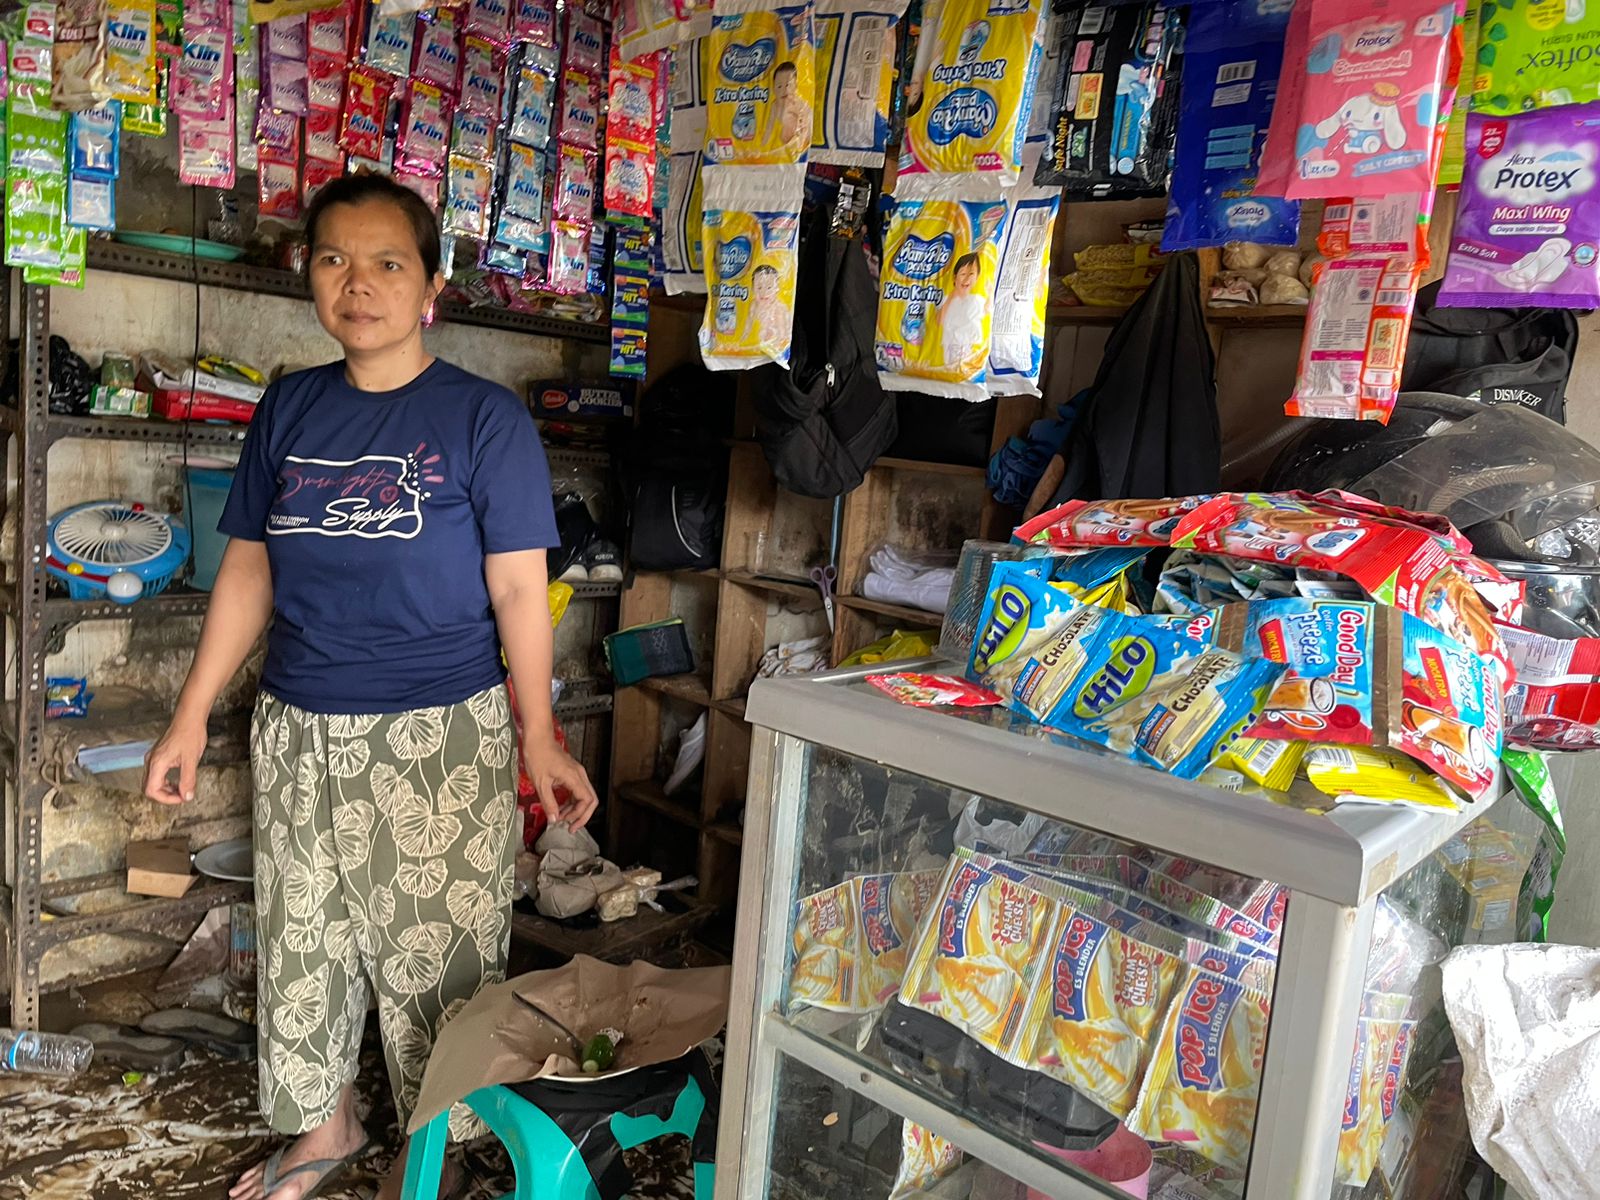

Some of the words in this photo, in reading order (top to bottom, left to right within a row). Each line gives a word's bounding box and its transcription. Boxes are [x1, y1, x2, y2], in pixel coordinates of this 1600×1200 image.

[108, 21, 147, 41] Klin
[375, 29, 408, 49] Klin
[573, 32, 599, 50] Klin
[1355, 34, 1395, 48] Protex
[1542, 34, 1573, 46] SIRIH
[184, 42, 221, 61] Klin
[426, 43, 456, 63] Klin
[468, 75, 498, 94] Klin
[739, 86, 769, 103] Kering
[350, 115, 378, 134] Klin
[521, 106, 547, 125] Klin
[568, 107, 594, 125] Klin
[411, 121, 444, 141] Klin
[460, 118, 487, 136] Klin
[1055, 116, 1068, 148] Night
[1505, 152, 1536, 167] Hers
[513, 180, 539, 198] Klin
[1494, 167, 1582, 193] Protex
[454, 199, 480, 212] Klin
[1492, 206, 1530, 220] Maxi
[1533, 205, 1572, 223] Wing
[1496, 225, 1514, 233] Daya
[624, 240, 641, 250] HIT
[1458, 243, 1479, 254] Extra
[1480, 248, 1498, 259] Soft
[622, 292, 639, 303] HIT
[910, 284, 944, 306] Kering
[620, 344, 636, 354] HIT
[579, 397, 622, 407] COOKIES
[580, 388, 621, 398] BUTTER
[322, 496, 406, 531] Supply
[1322, 608, 1334, 632] Coffee
[1041, 610, 1093, 668] CHOCOLATE
[1288, 609, 1325, 665] Freeze
[1337, 609, 1365, 655] Good
[1329, 655, 1364, 686] Day
[1171, 655, 1231, 715] CHOCOLATE
[1480, 711, 1500, 748] Day
[958, 883, 979, 918] BLENDER
[938, 898, 958, 953] POP
[954, 916, 964, 930] ES
[1000, 895, 1015, 937] CREAM
[1011, 896, 1027, 945] CHEESE
[1078, 938, 1097, 978] BLENDER
[1054, 959, 1080, 1015] POP
[1073, 976, 1084, 991] ES
[1119, 958, 1138, 1001] CREAM
[1132, 959, 1152, 1008] CHEESE
[1210, 1000, 1231, 1044] BLENDER
[1180, 1014, 1212, 1085] POP
[1206, 1042, 1218, 1057] ES
[1383, 1069, 1398, 1118] POP
